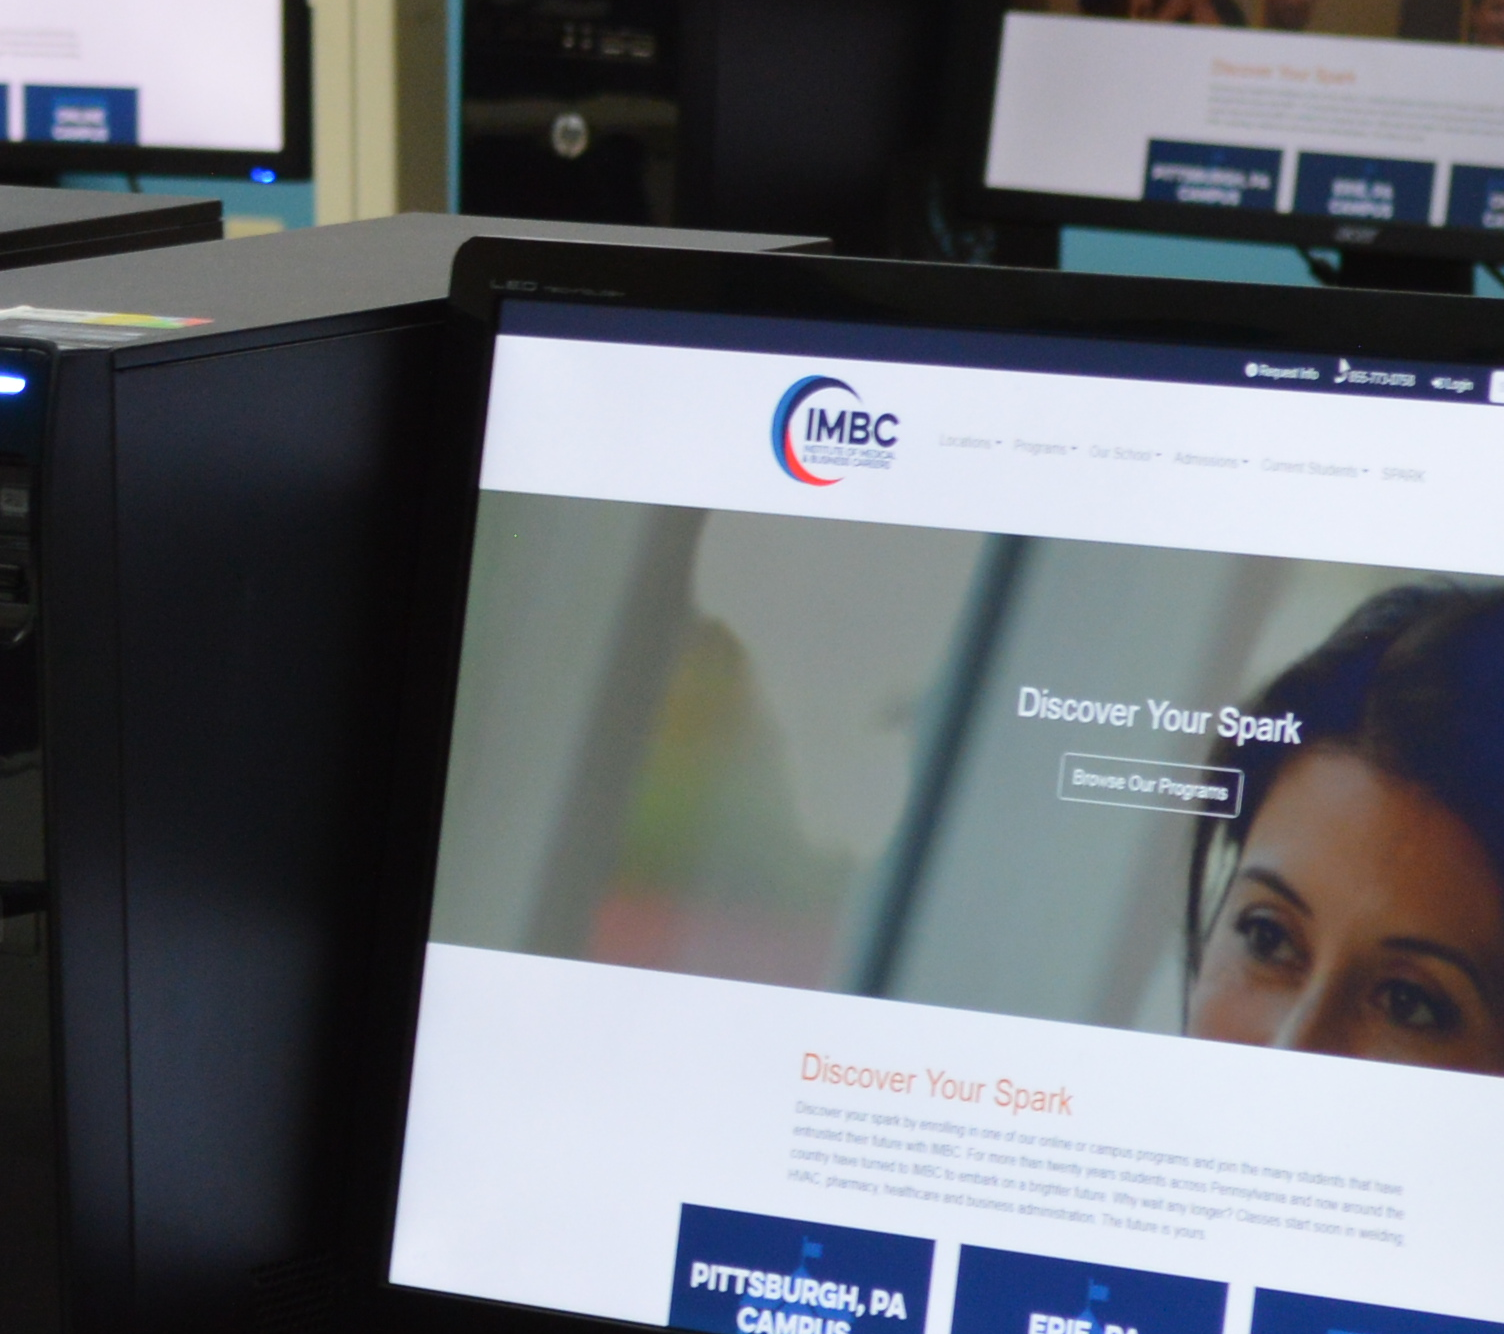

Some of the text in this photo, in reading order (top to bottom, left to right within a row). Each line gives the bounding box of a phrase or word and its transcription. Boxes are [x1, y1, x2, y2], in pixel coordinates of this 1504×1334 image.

[805, 407, 900, 449] IMBC
[1018, 687, 1302, 744] Discover Your Spark
[1072, 769, 1229, 800] Browse Our Programs
[801, 1053, 1072, 1115] Discover Your Spark
[691, 1262, 908, 1322] PITTSBURGH, PA
